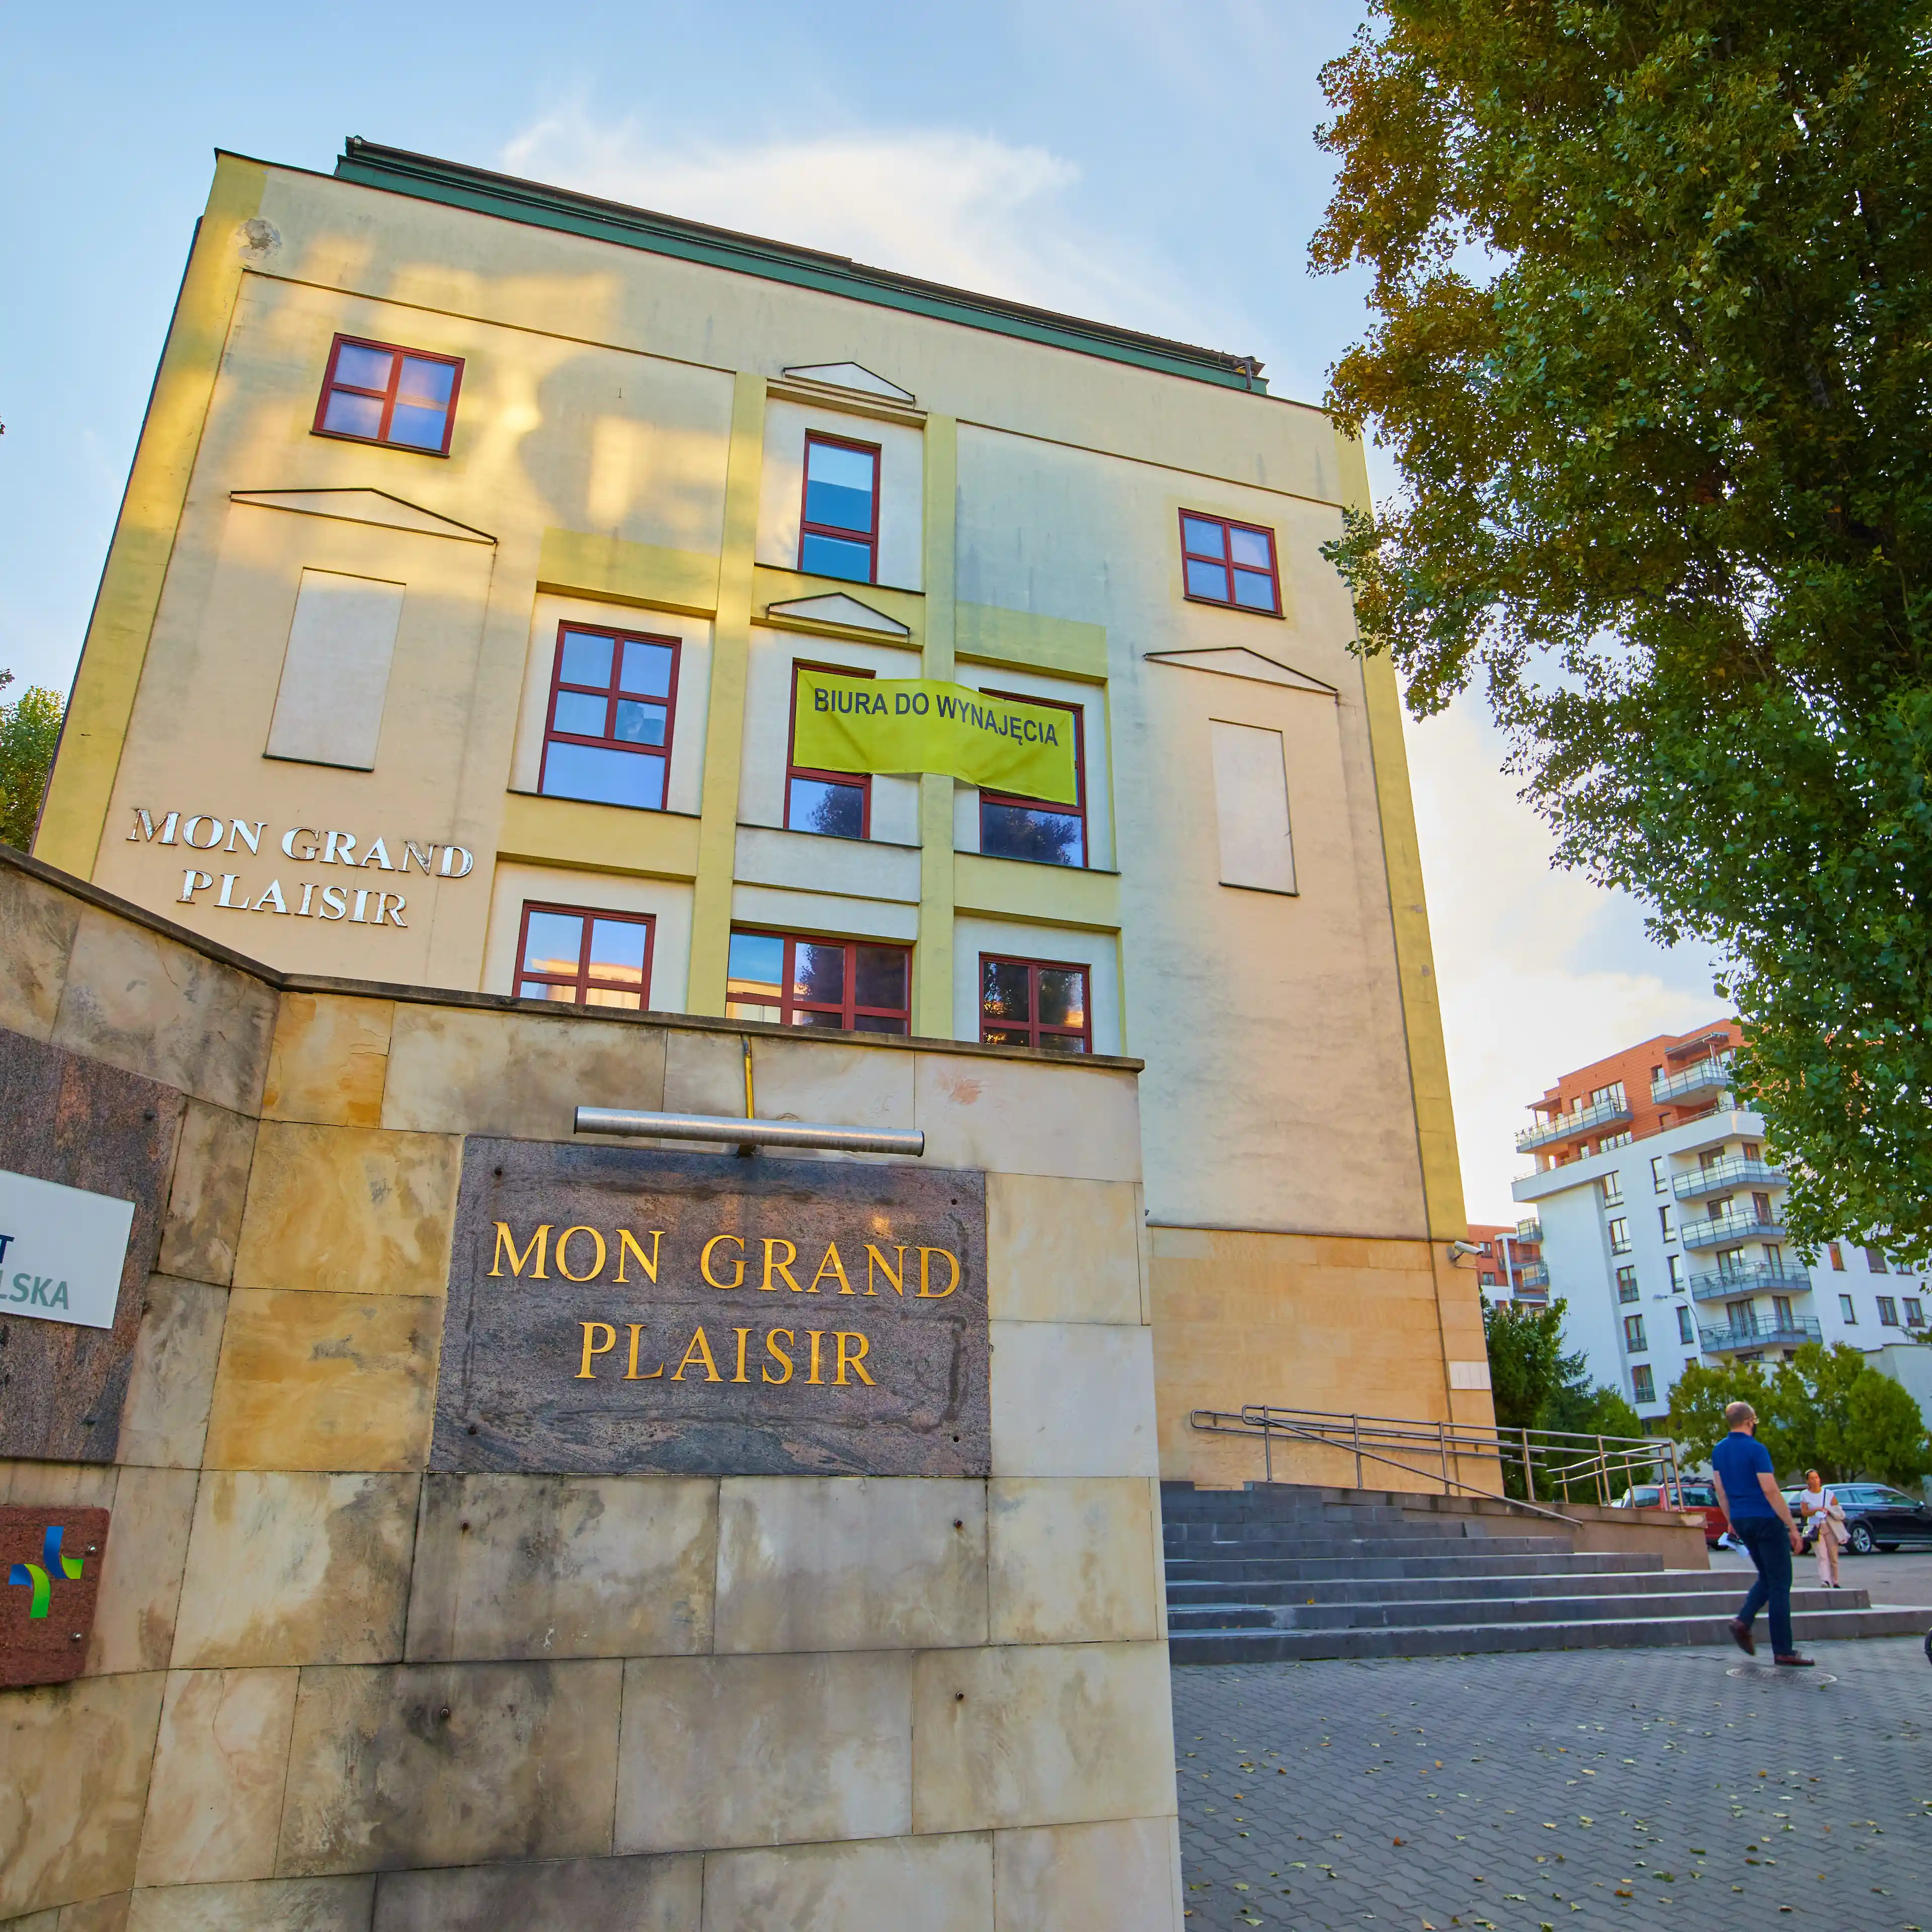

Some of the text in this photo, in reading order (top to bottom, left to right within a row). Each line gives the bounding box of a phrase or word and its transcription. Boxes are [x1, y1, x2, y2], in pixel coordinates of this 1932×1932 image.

[814, 688, 1059, 746] BIURA DO WYNAJĘCIA
[126, 808, 474, 878] MON GRAND
[176, 869, 408, 928] PLAISIR
[487, 1222, 960, 1299] MON GRAND
[574, 1321, 876, 1386] PLAISIR
